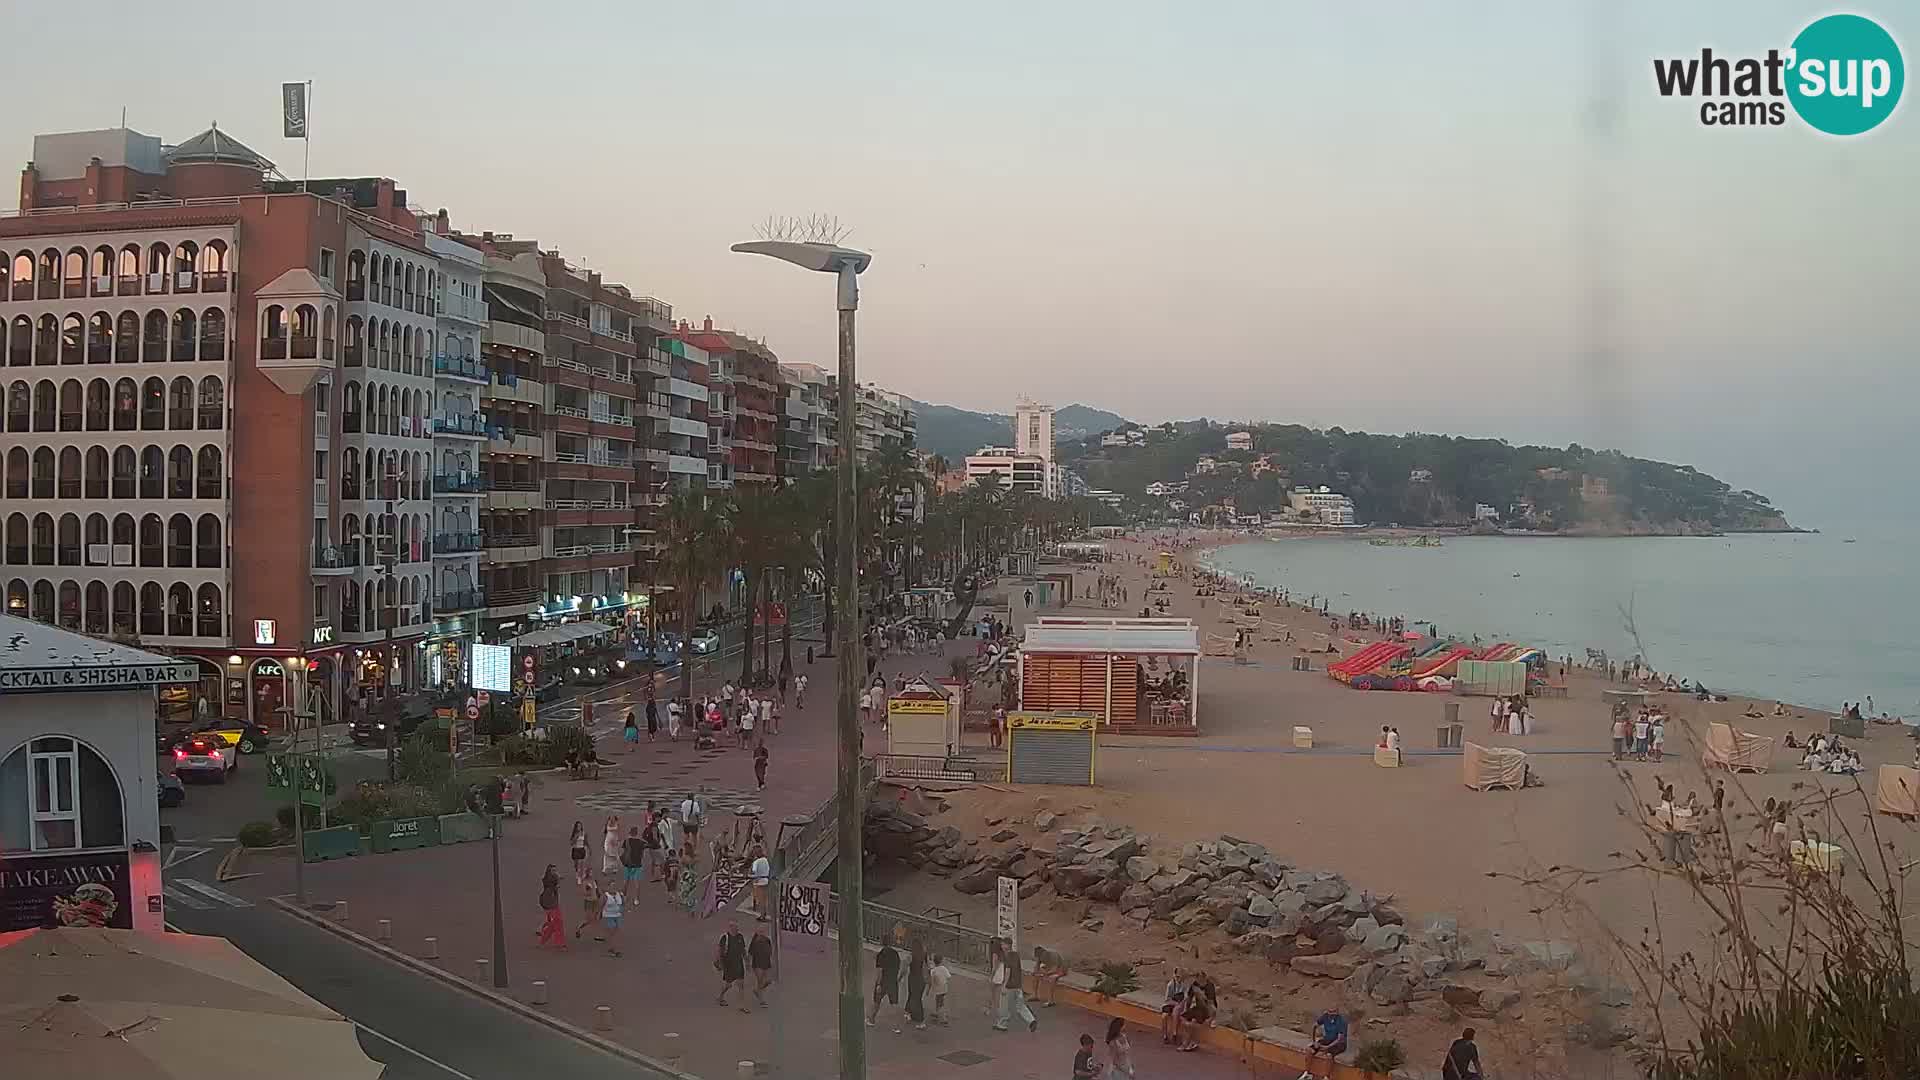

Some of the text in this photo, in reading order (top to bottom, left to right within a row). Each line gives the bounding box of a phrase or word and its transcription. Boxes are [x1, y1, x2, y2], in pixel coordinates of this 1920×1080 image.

[314, 626, 332, 643] KFC
[63, 671, 74, 684] &
[79, 669, 140, 684] SHISHA
[146, 667, 178, 682] BAR
[258, 665, 280, 675] KFC
[393, 820, 418, 832] lloret
